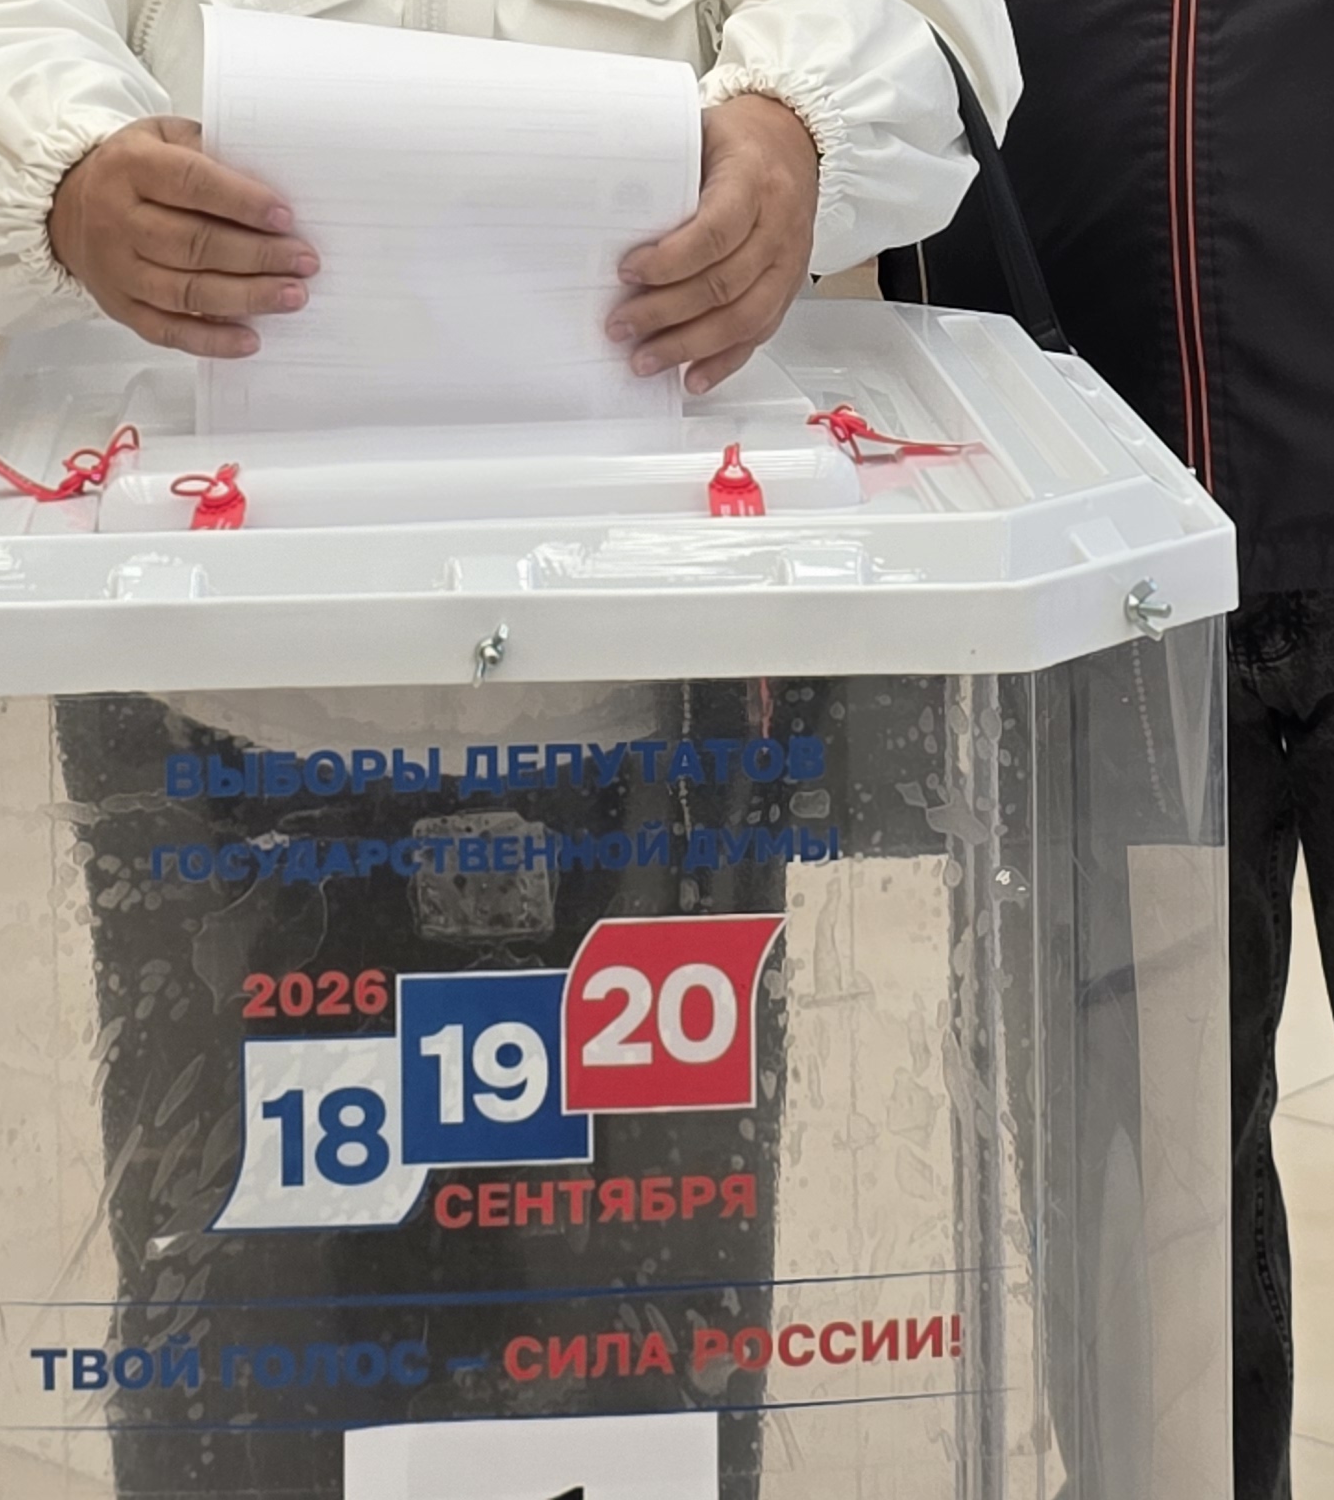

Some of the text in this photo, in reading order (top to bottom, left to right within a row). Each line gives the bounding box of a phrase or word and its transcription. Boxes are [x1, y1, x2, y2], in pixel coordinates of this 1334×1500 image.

[165, 735, 827, 798] ВЫБОРЫ ДЕПУТАТОВ
[150, 821, 839, 885] ГОСУДАРСТВЕННОЙ ДУМЫ
[242, 969, 388, 1018] 2026
[581, 963, 738, 1067] 20
[420, 1021, 549, 1124] 19
[262, 1086, 390, 1187] 18
[433, 1174, 758, 1229] СЕНТЯБРЯ
[30, 1334, 201, 1392] ТВОЙ
[220, 1340, 430, 1390] ГОЛОС
[504, 1332, 676, 1382] СИЛА
[692, 1314, 963, 1373] РОССИИ!
